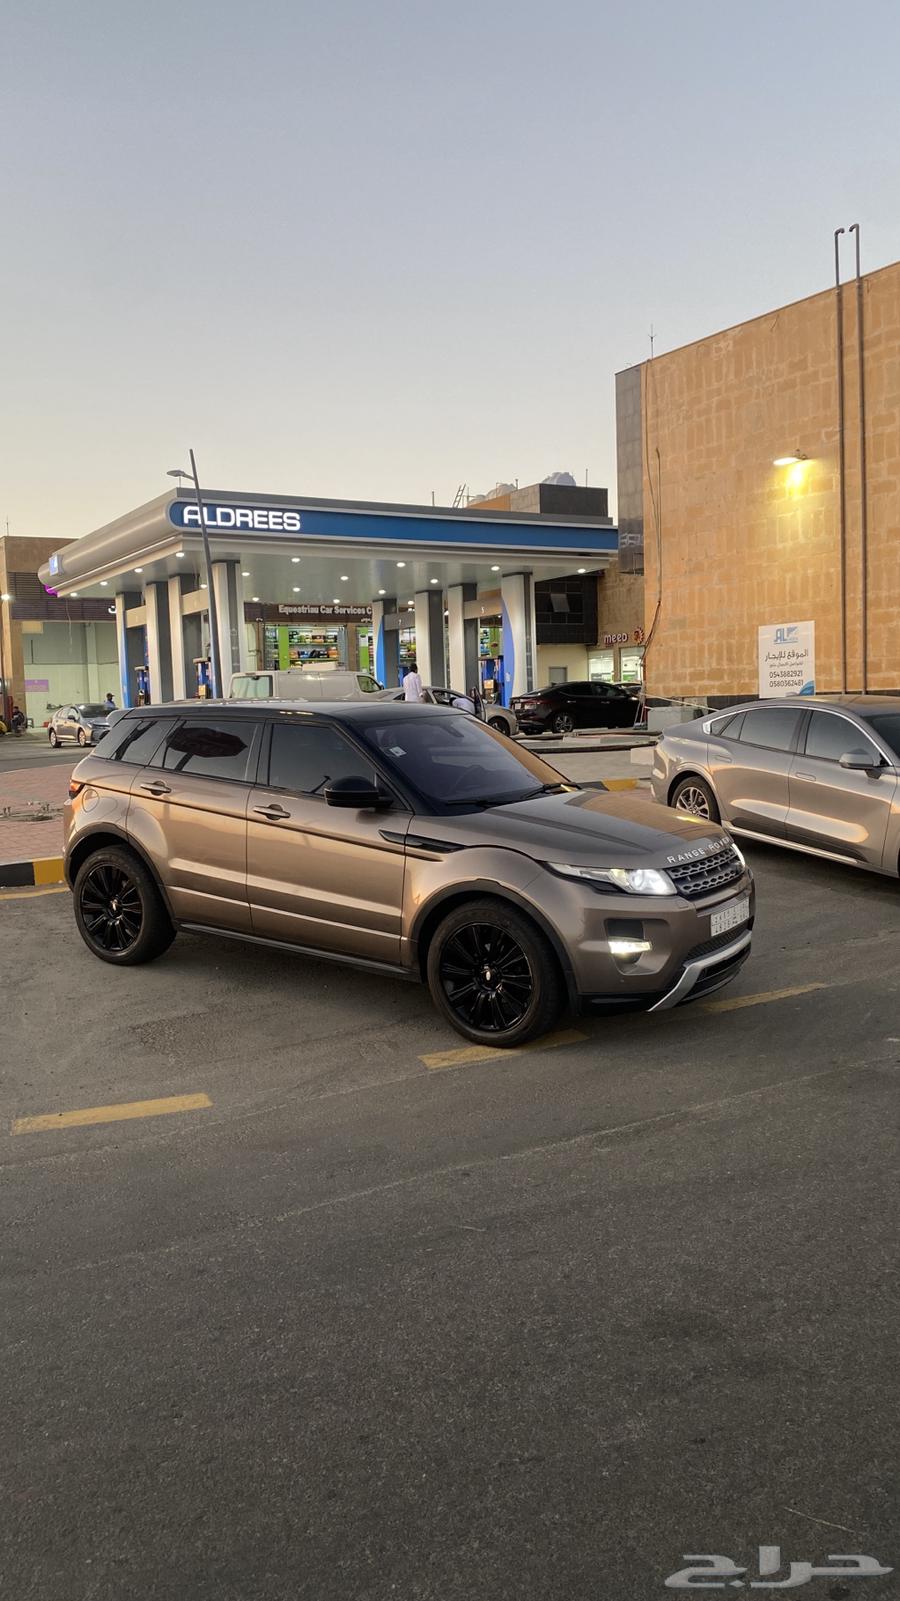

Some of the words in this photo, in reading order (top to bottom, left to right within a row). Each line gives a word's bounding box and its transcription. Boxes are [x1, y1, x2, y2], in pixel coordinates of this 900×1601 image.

[183, 506, 300, 531] ALDREES
[320, 605, 333, 614] Car
[666, 847, 706, 864] RANGE
